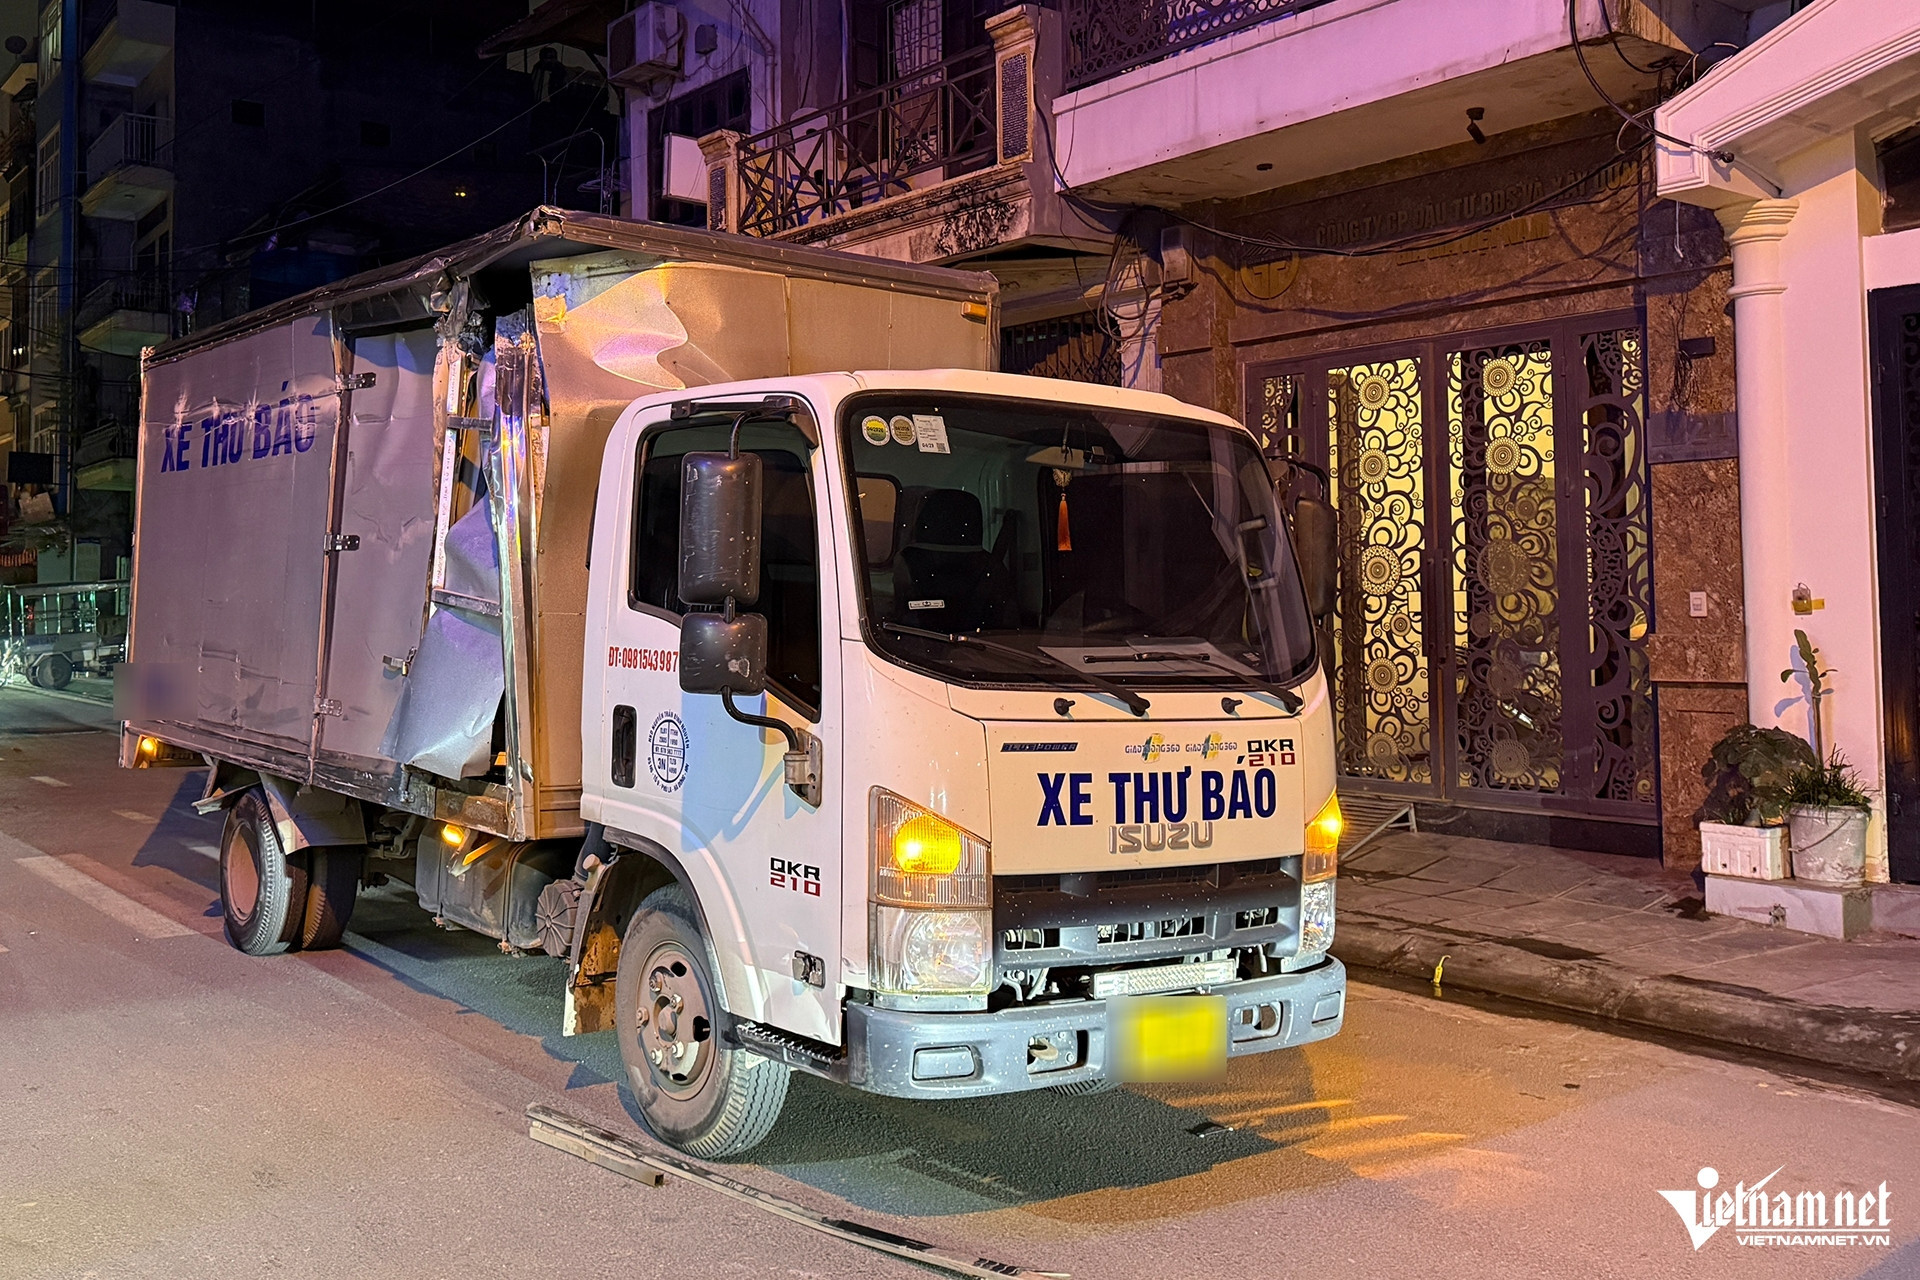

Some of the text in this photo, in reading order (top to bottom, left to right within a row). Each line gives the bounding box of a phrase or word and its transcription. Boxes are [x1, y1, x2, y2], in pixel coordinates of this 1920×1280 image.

[161, 421, 193, 473] XE
[252, 381, 316, 460] BÁO
[1247, 738, 1295, 753] QKR
[1248, 752, 1296, 767] 210
[1036, 755, 1277, 827] XE THƯ BÁO
[1108, 821, 1214, 854] ISUZU
[770, 858, 821, 883] QKR
[770, 872, 821, 897] 210
